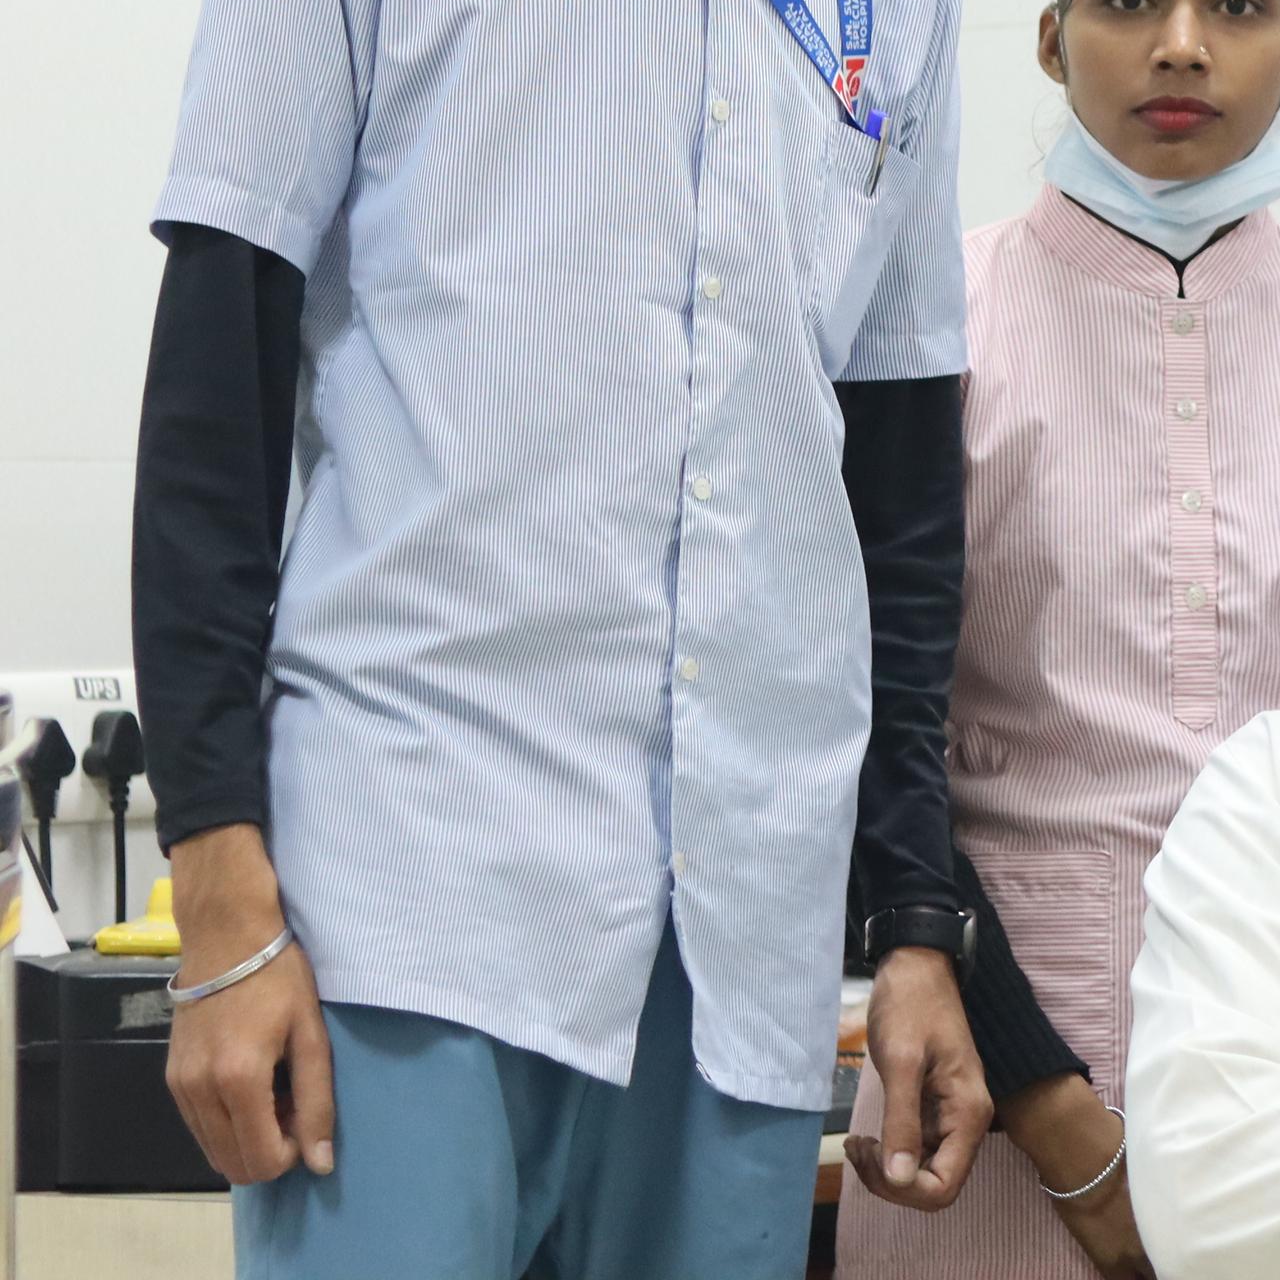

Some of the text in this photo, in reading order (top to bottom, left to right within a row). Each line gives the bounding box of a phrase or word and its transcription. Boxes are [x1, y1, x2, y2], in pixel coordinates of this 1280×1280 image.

[784, 10, 813, 52] SUPER
[787, 2, 830, 68] SPECIALITY
[798, 5, 836, 68] HOSPITAL
[844, 19, 853, 50] S.N.
[78, 677, 118, 701] UPS
